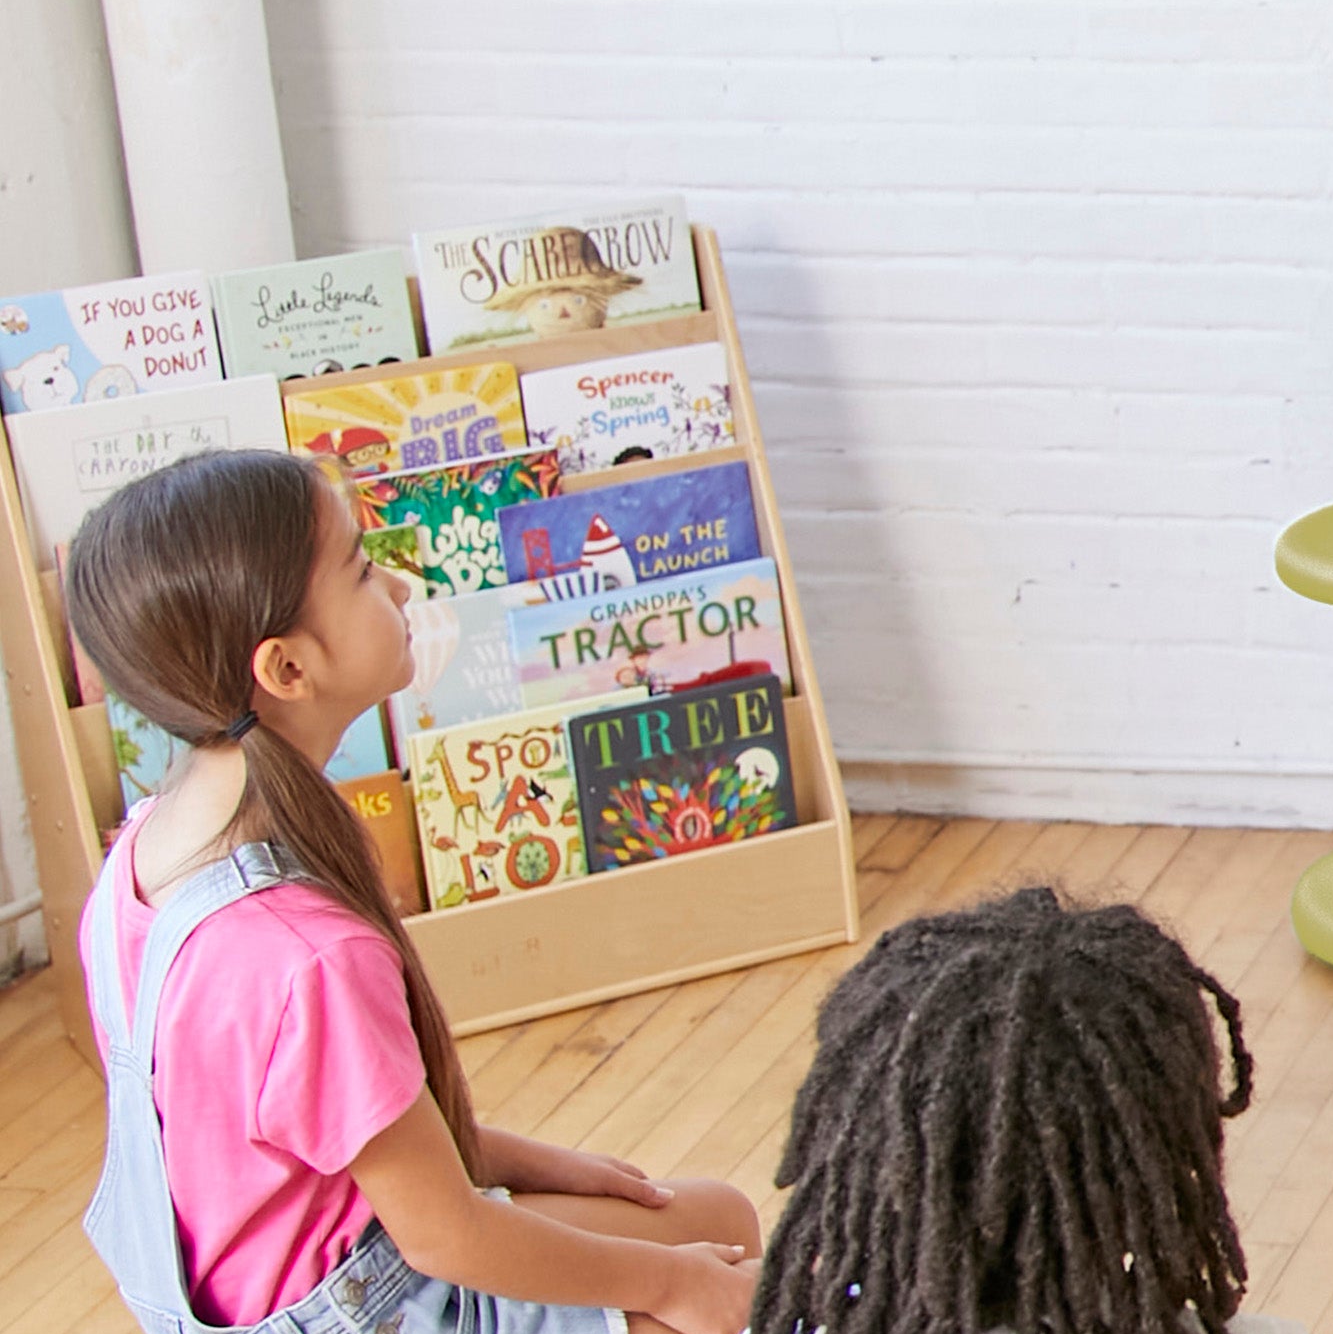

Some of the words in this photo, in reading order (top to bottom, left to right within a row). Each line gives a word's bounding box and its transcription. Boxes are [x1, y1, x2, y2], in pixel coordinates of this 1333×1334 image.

[81, 300, 101, 324] IF
[107, 296, 145, 318] YOU
[151, 289, 202, 312] GIVE
[312, 272, 383, 313] Legends
[124, 329, 136, 350] A
[142, 322, 185, 345] DOG
[192, 319, 204, 339] A
[144, 346, 207, 377] DONUT
[576, 369, 674, 399] Spencer
[410, 403, 477, 435] Dream
[590, 405, 670, 437] Spring
[400, 415, 506, 469] BIG
[634, 532, 670, 553] ON
[679, 518, 728, 545] THE
[639, 544, 730, 577] LAUNCH
[589, 584, 707, 622] GRANDPA'S
[539, 594, 761, 669] TRACTOR
[582, 687, 775, 770] TREE
[466, 735, 555, 784] SPO
[494, 774, 551, 833] A
[460, 834, 561, 903] LO
